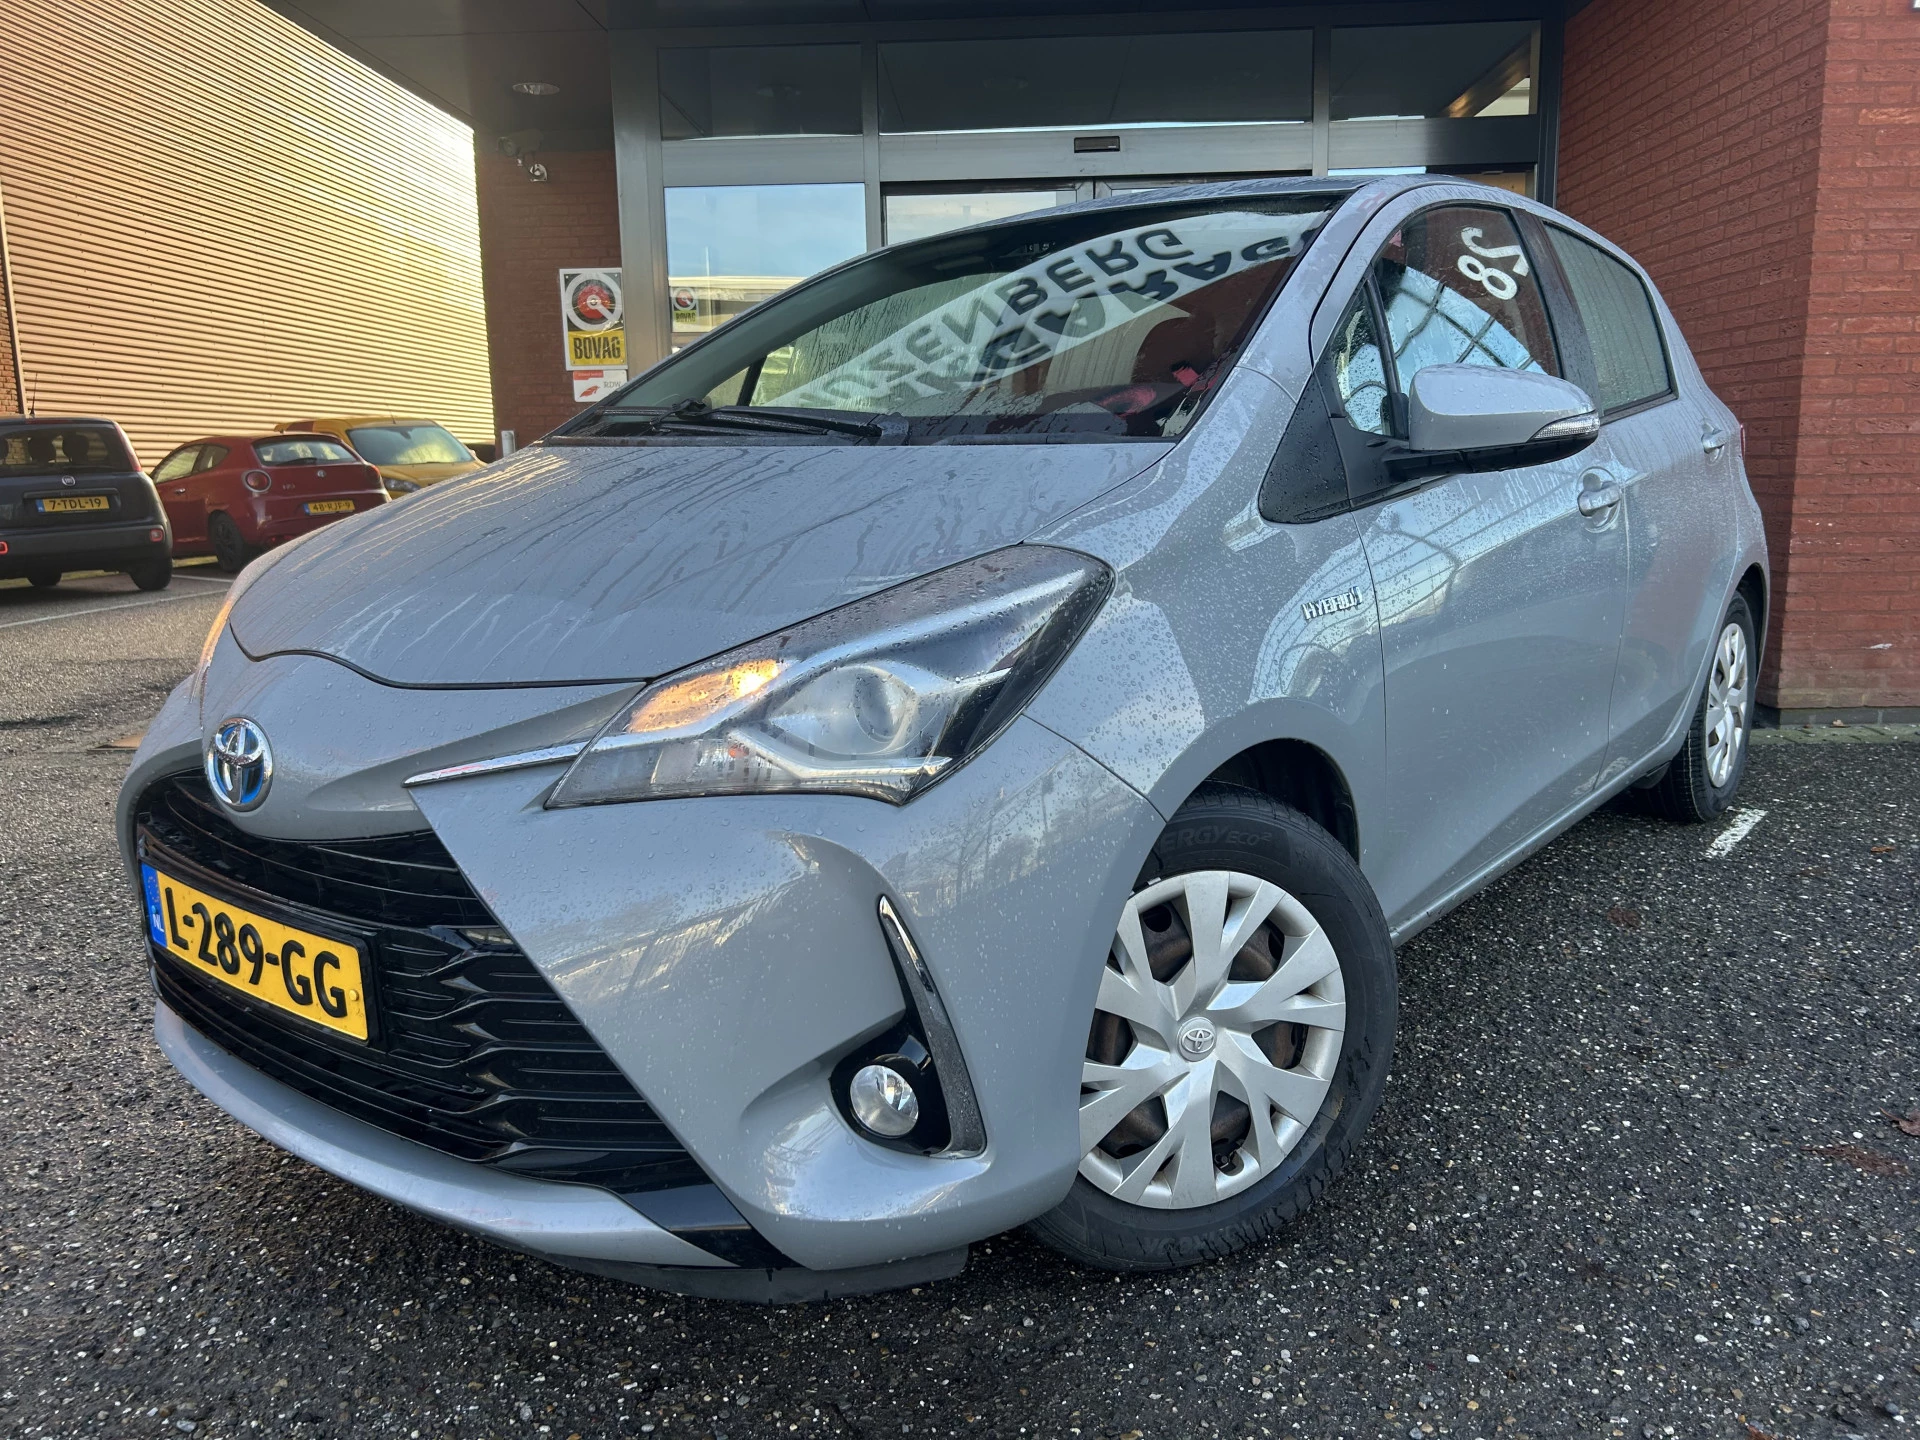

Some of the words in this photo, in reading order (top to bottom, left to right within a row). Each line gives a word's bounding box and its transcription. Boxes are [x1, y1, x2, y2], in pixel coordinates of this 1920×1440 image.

[573, 336, 621, 360] BOVAG
[603, 381, 622, 389] RDW
[49, 498, 102, 510] 7-TDL-19
[1302, 589, 1358, 620] HYBRID
[1160, 825, 1229, 854] ERGY
[152, 914, 165, 933] NL
[164, 886, 348, 1018] L-289-GG
